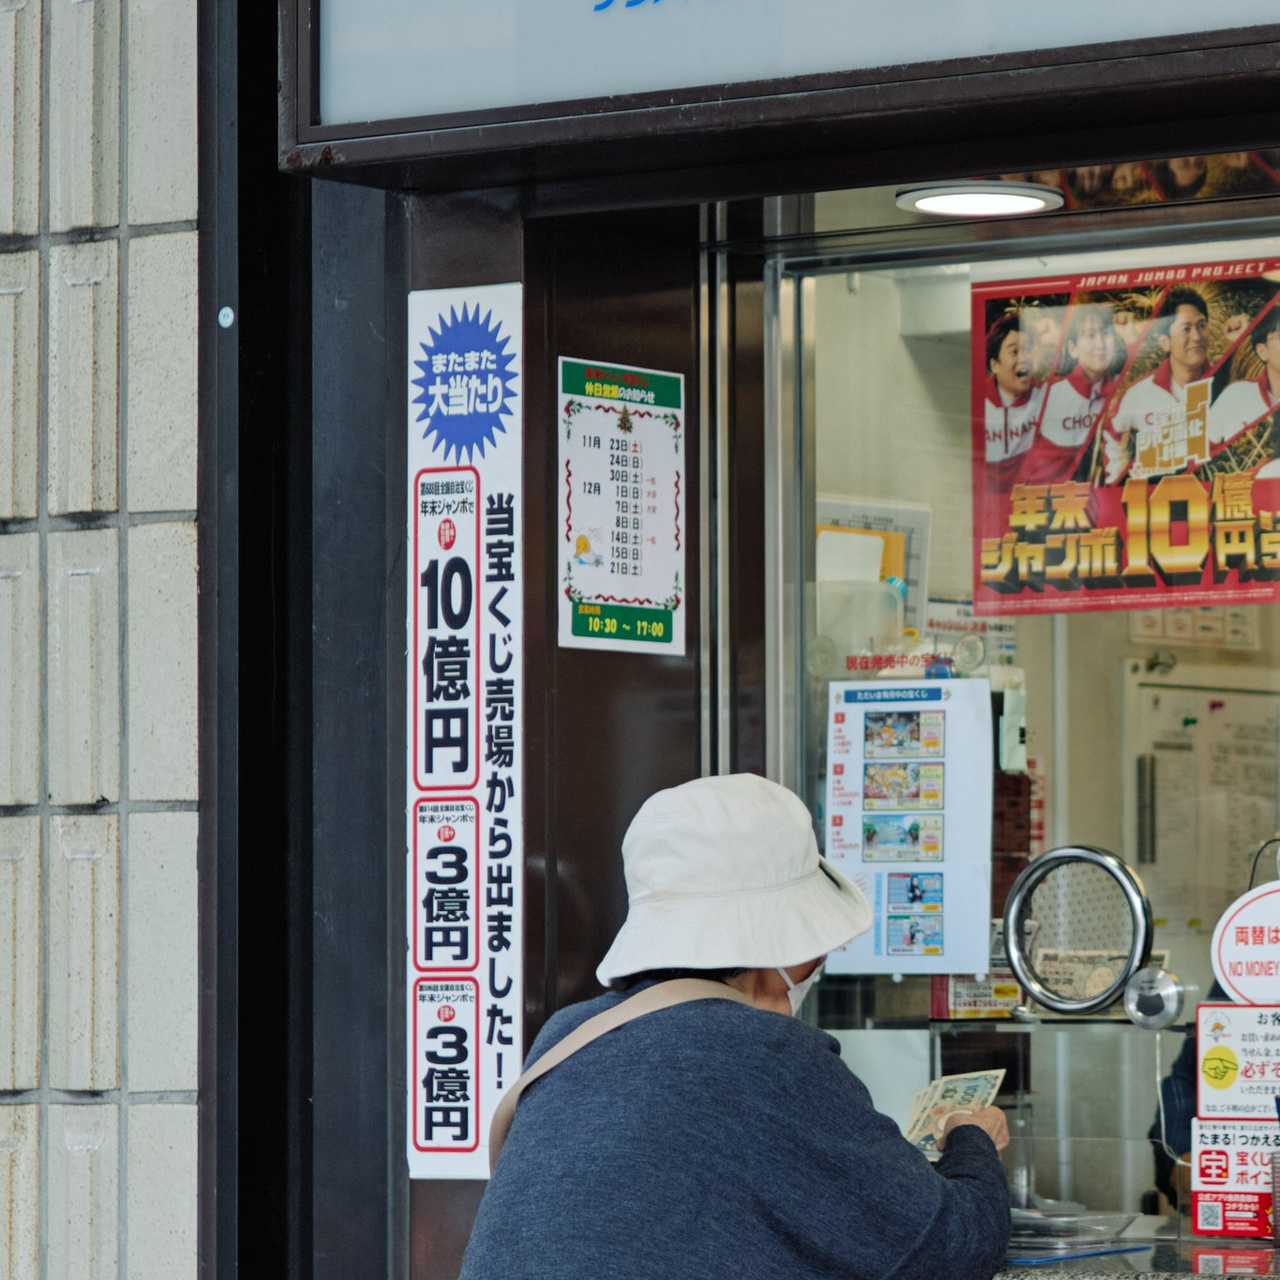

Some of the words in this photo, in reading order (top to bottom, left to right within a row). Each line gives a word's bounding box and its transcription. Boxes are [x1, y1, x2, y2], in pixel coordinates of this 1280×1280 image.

[1075, 273, 1129, 289] JAPAN
[1132, 267, 1188, 284] JUMBO
[1191, 261, 1267, 279] PROJECT
[432, 349, 497, 371] またまた
[428, 376, 502, 417] 大当たり
[583, 435, 601, 449] 11月
[583, 482, 601, 495] 12月
[1009, 481, 1094, 529] 年末
[420, 497, 474, 516] 年末ジャンボで
[980, 525, 1121, 581] ジャンボ
[420, 556, 473, 774] 10億円
[856, 690, 928, 700] ただいま発売中の宝くじ
[485, 492, 515, 1090] 当宝くじ売場から出ました！
[422, 846, 471, 961] 3億円
[1228, 961, 1244, 977] NO
[1245, 960, 1280, 977] MONEY
[422, 1026, 471, 1142] 3億円
